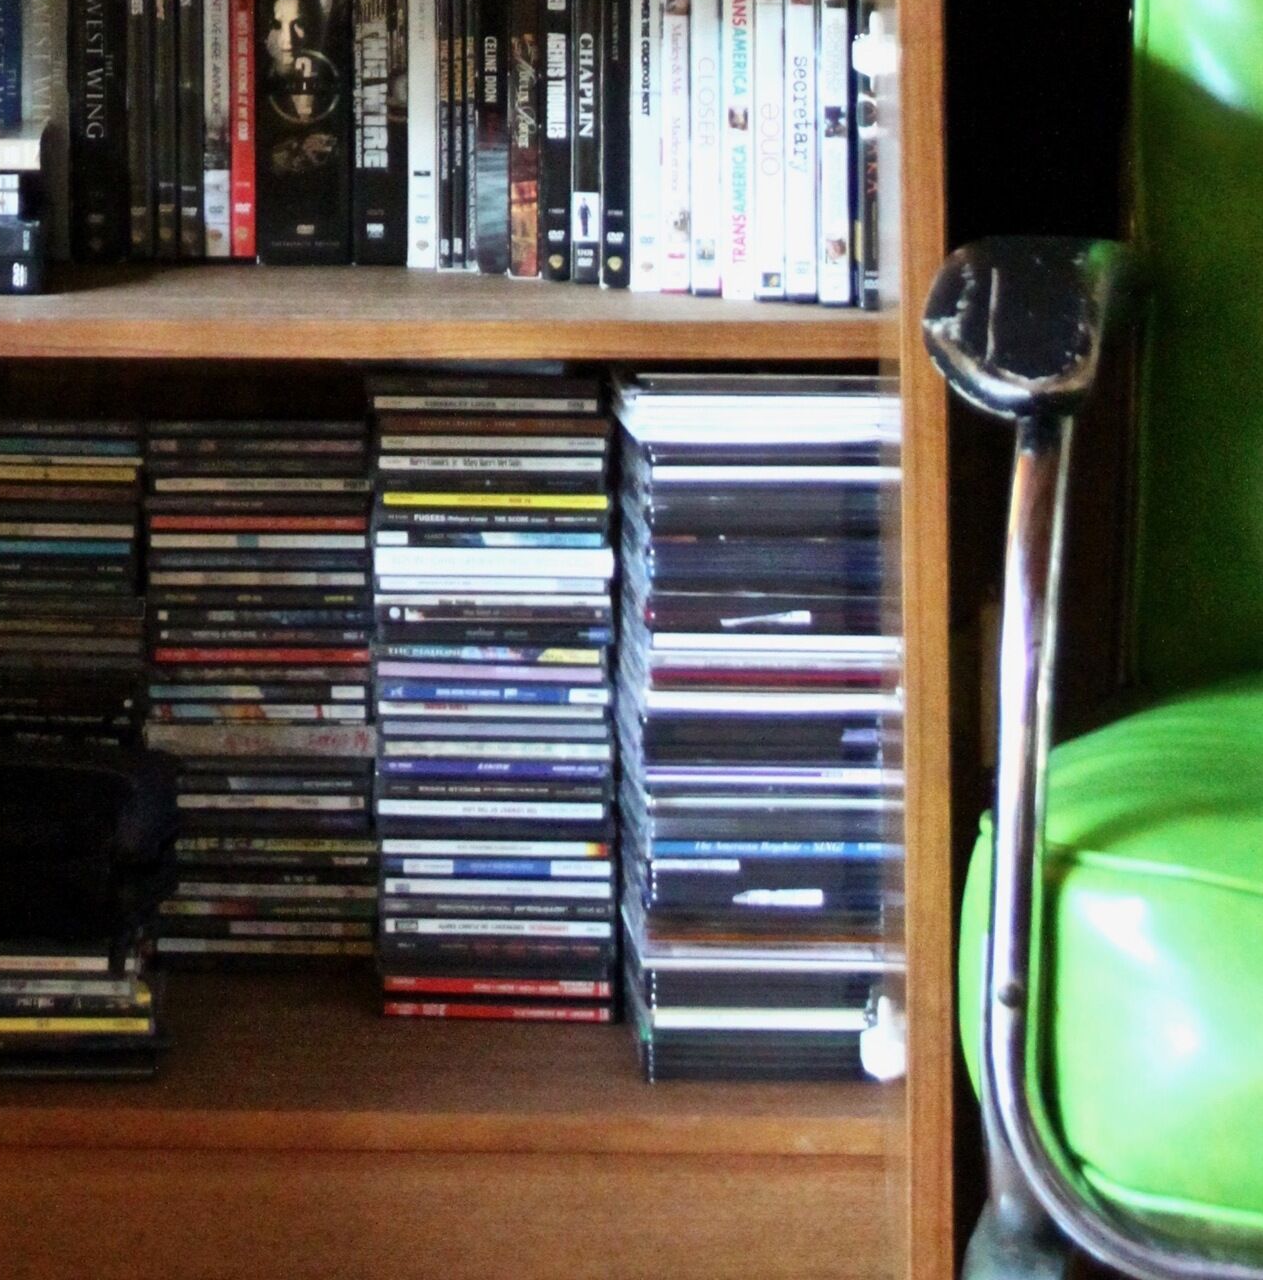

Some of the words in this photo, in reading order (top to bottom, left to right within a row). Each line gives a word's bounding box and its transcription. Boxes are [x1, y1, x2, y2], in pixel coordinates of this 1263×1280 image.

[363, 21, 387, 78] THE
[485, 36, 498, 72] CELINE
[547, 33, 566, 77] AGENTS
[578, 32, 594, 138] CHAPLIN
[85, 68, 104, 140] WING
[485, 75, 498, 103] DION
[698, 57, 715, 146] CLOSER
[789, 56, 812, 173] secretary
[363, 83, 387, 168] WIRE
